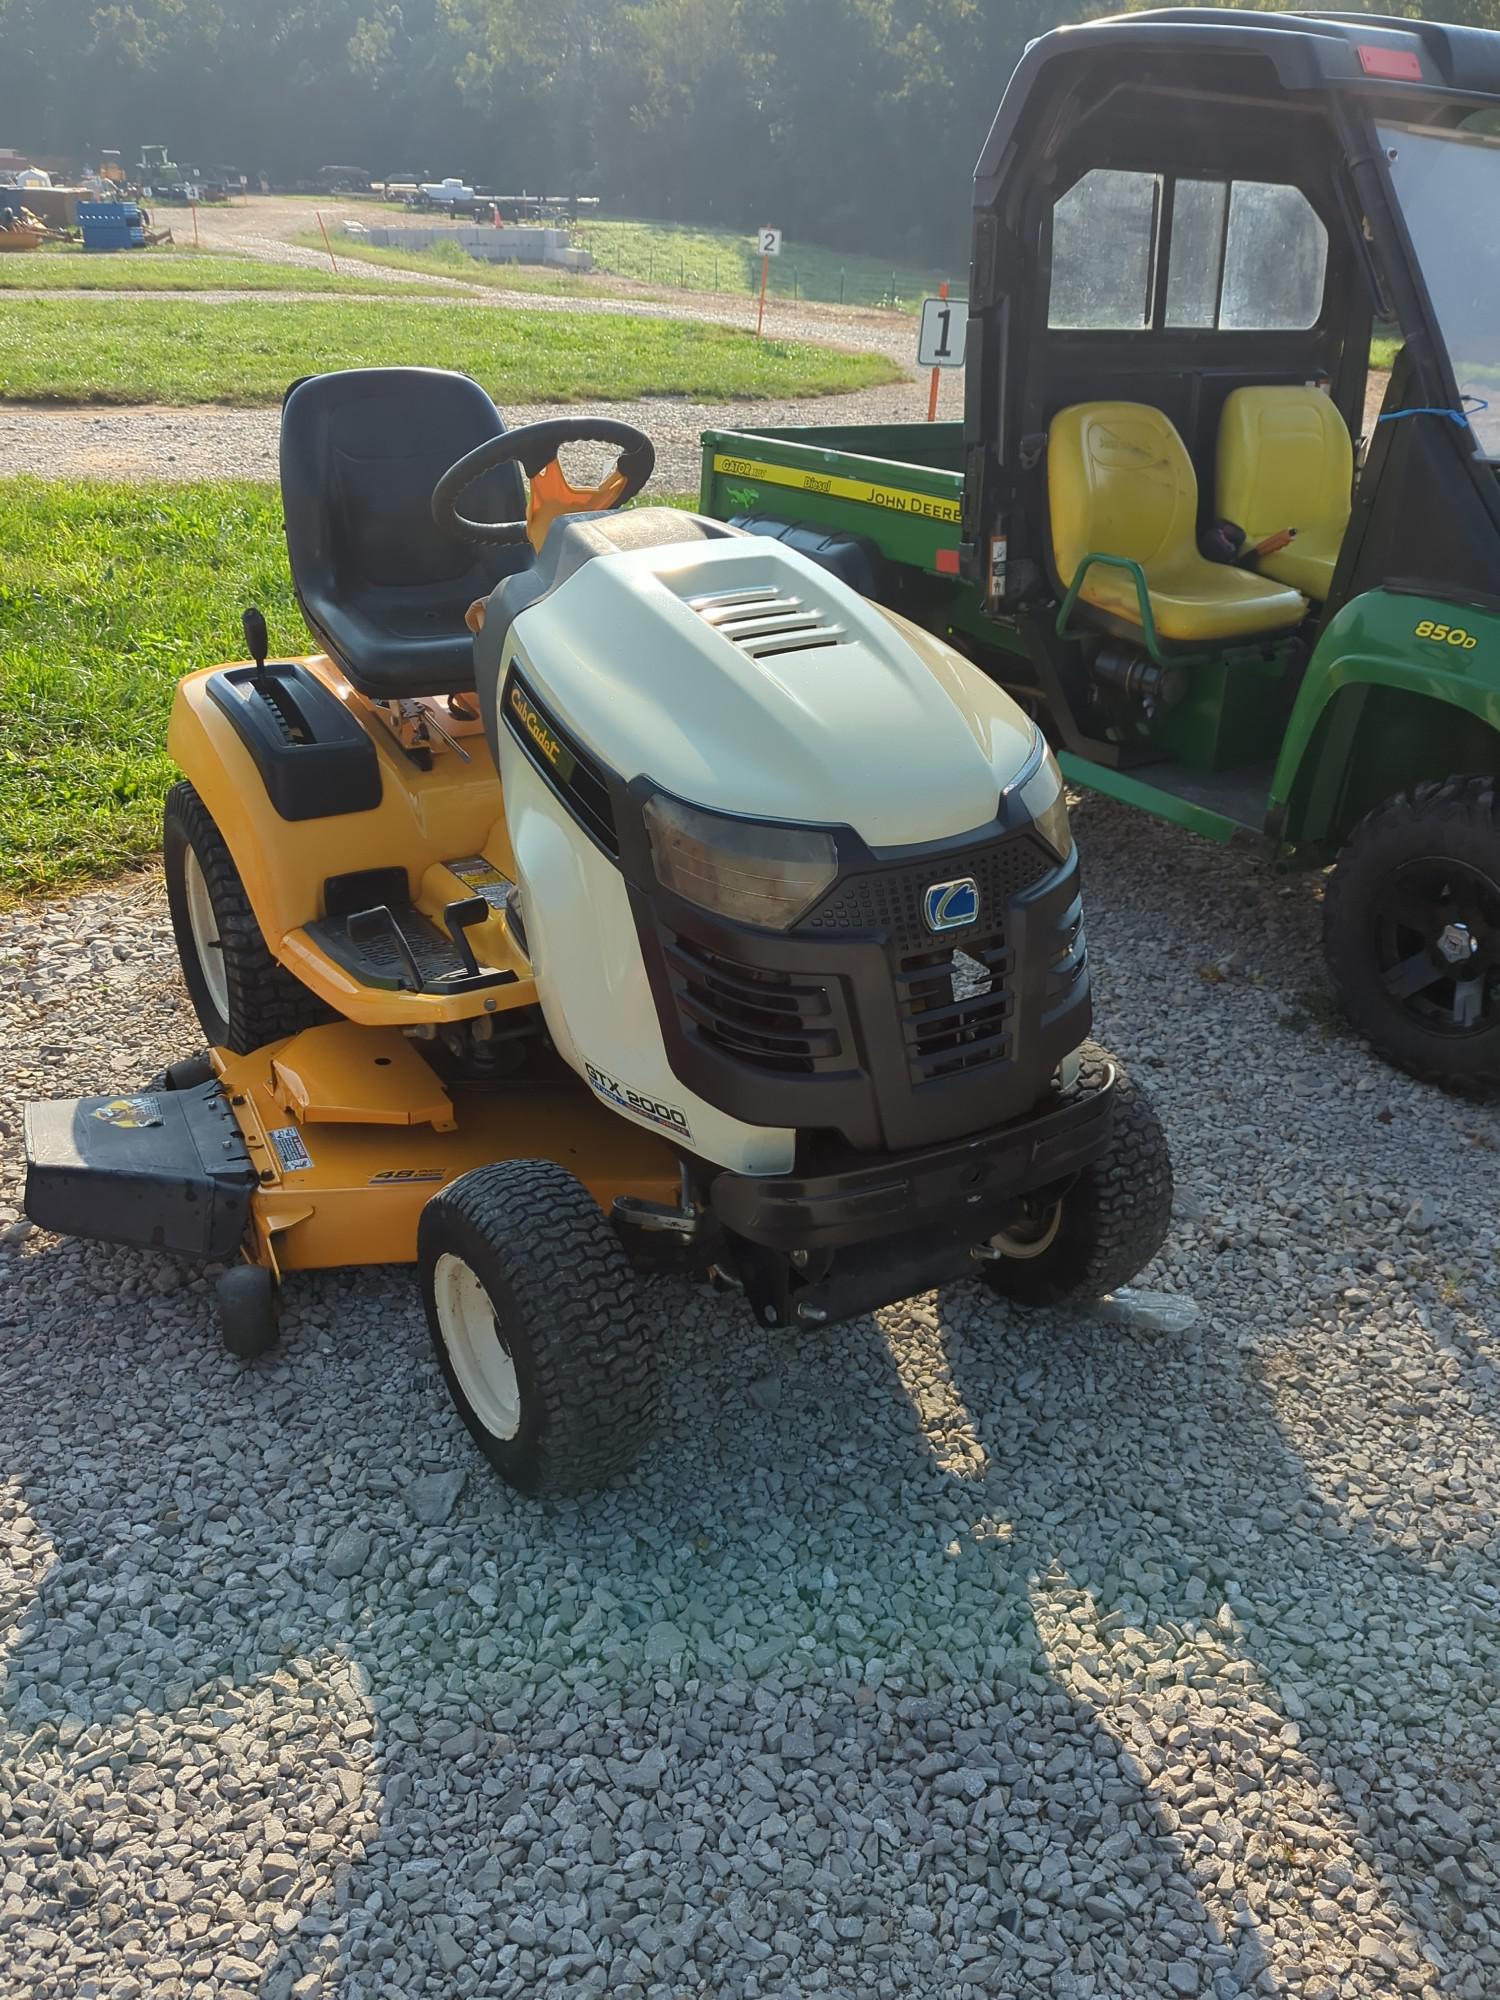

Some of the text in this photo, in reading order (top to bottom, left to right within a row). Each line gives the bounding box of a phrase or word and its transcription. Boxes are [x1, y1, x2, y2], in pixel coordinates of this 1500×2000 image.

[764, 232, 775, 252] 2
[934, 309, 951, 357] 1
[722, 459, 752, 476] GATOR
[803, 476, 832, 493] Diesel
[866, 488, 906, 509] JOHN
[512, 689, 560, 764] Cub Cadet
[585, 1062, 622, 1097] GTX
[626, 1090, 687, 1127] 2000
[375, 1170, 414, 1179] 48
